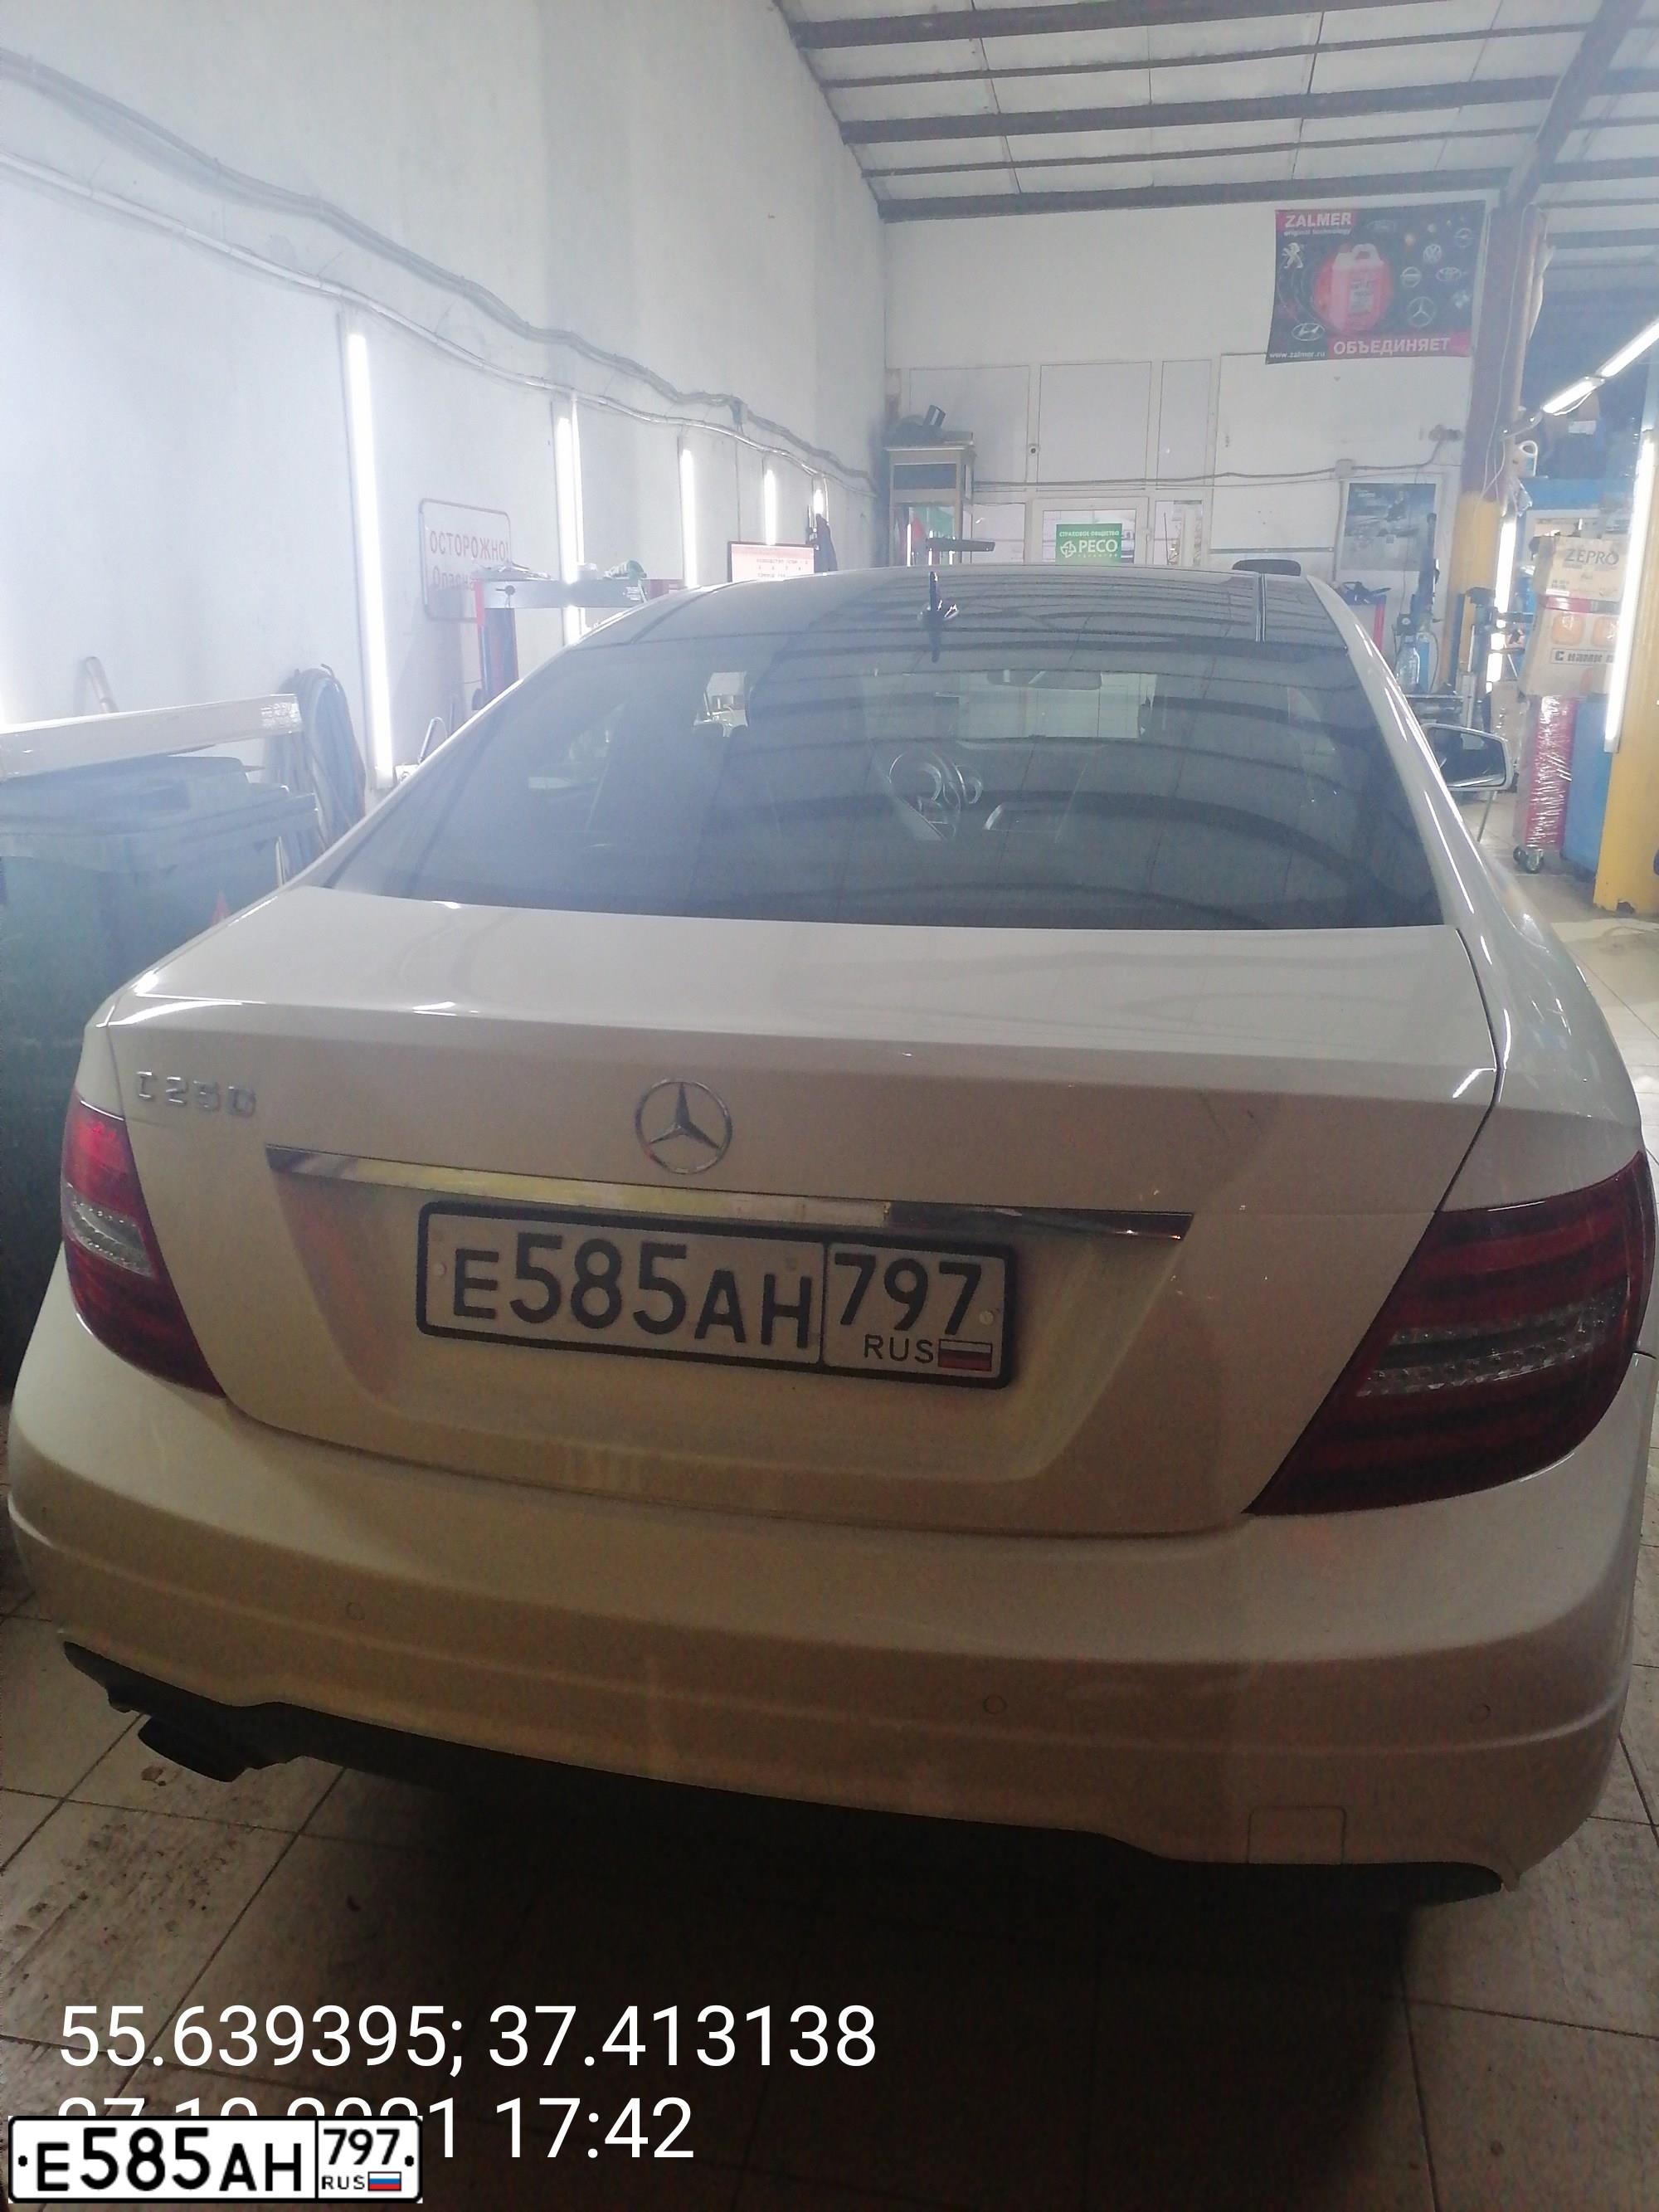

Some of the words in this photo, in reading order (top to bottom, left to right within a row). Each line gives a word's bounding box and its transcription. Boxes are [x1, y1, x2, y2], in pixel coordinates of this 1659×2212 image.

[1285, 212, 1352, 228] ZALMER
[1333, 337, 1451, 356] ОБЪЕДИНЯЕТ
[430, 530, 509, 563] ОСТОРОЖНО!
[1078, 539, 1118, 553] РЕСО
[1564, 548, 1620, 565] ZEPRO
[834, 1253, 983, 1336] 797
[864, 1334, 935, 1365] RUS
